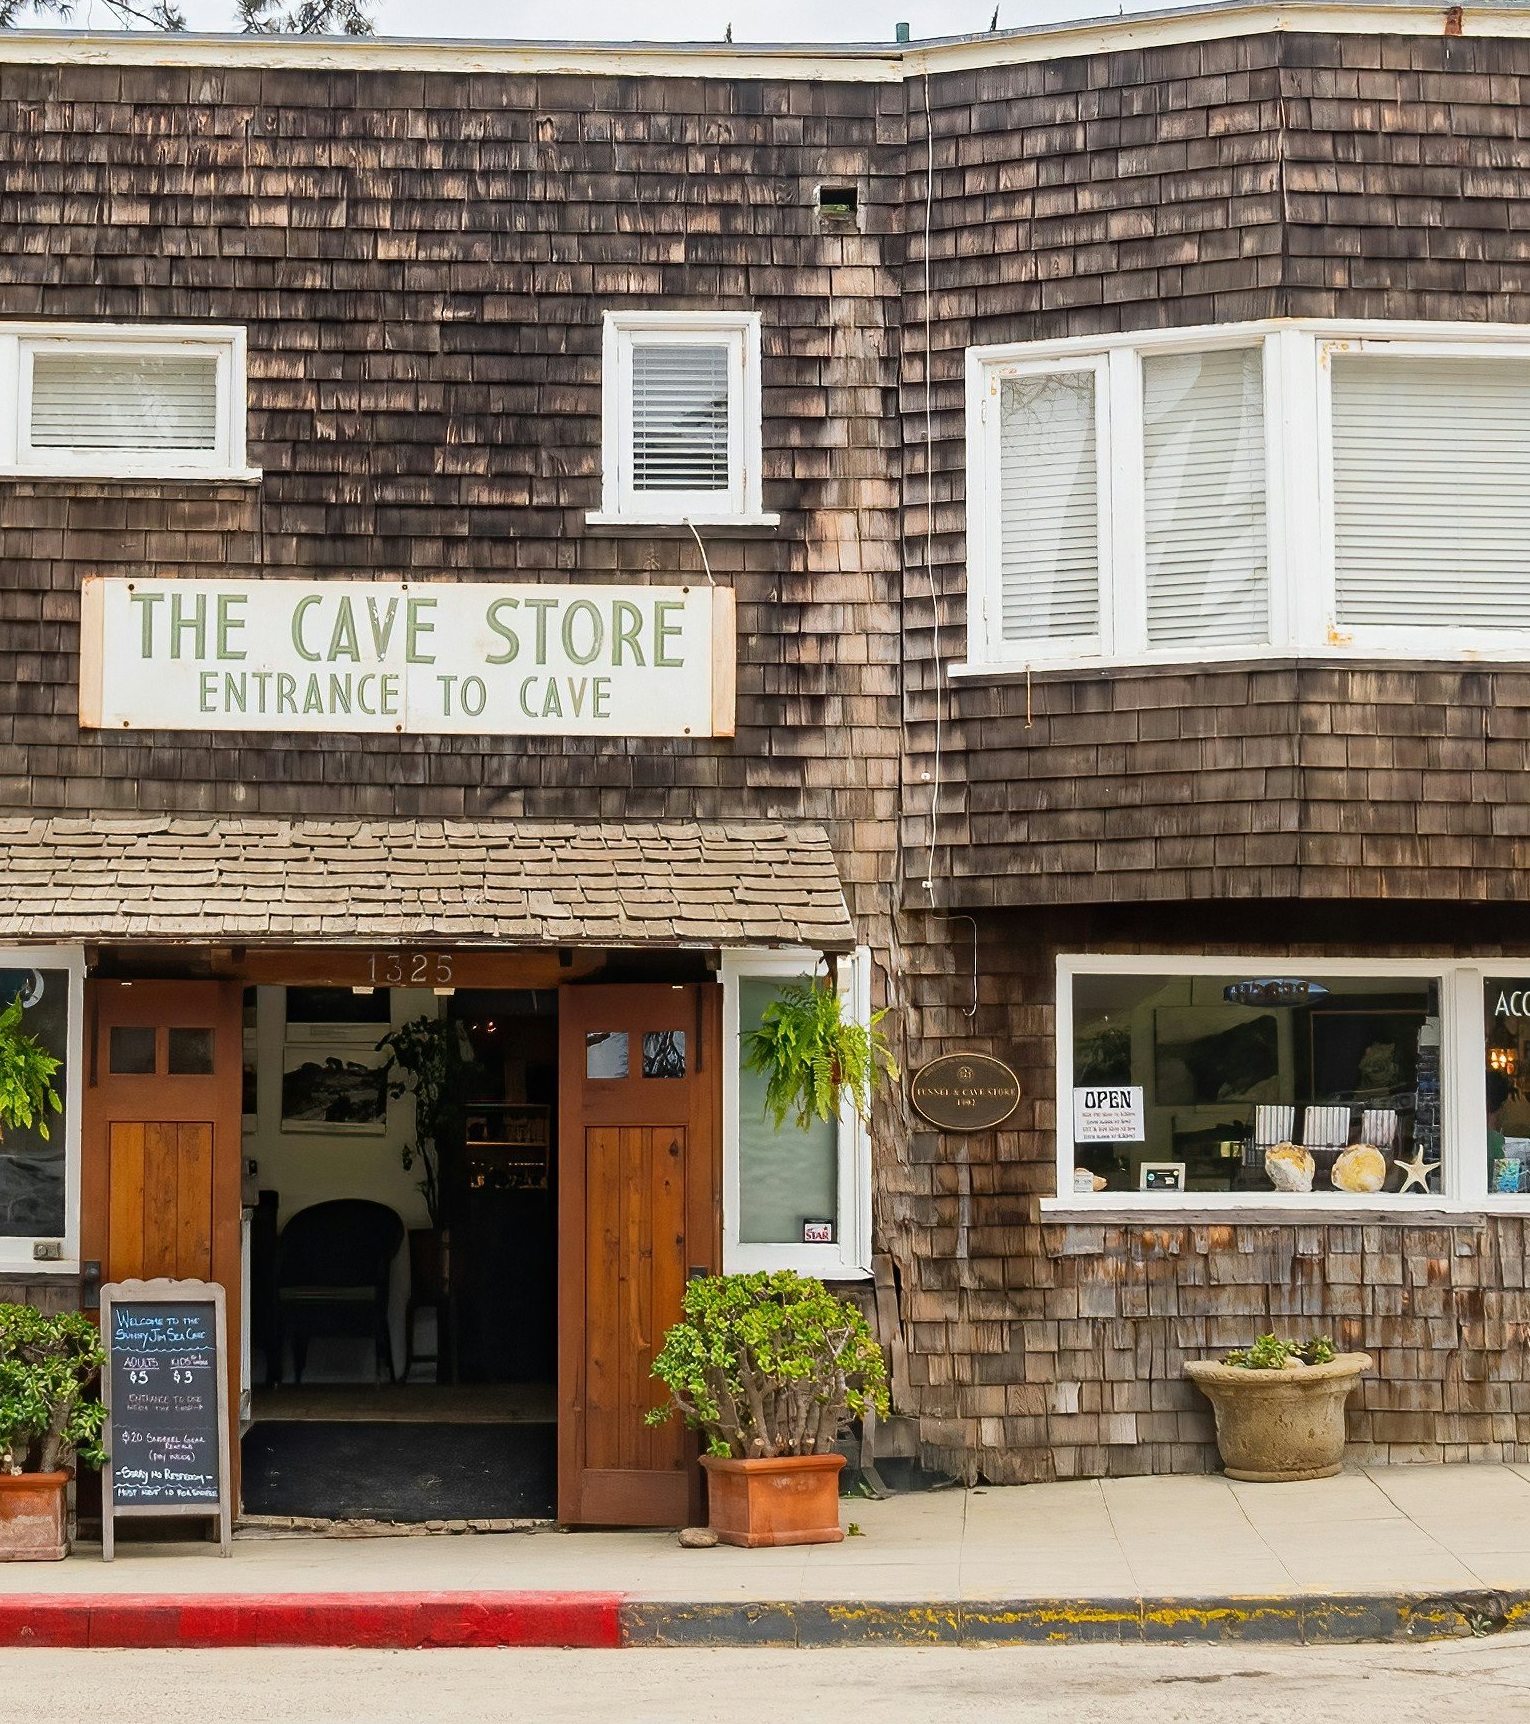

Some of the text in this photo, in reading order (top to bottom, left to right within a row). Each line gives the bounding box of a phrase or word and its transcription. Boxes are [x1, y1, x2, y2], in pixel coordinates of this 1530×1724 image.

[130, 592, 686, 669] THE CAVE STORE
[199, 670, 613, 719] ENTRANCE TO CAVE
[368, 953, 453, 983] 1325
[962, 1087, 984, 1097] CAVE
[1084, 1090, 1132, 1109] OPEN
[123, 1356, 159, 1367] ADULTS
[129, 1370, 149, 1385] $5
